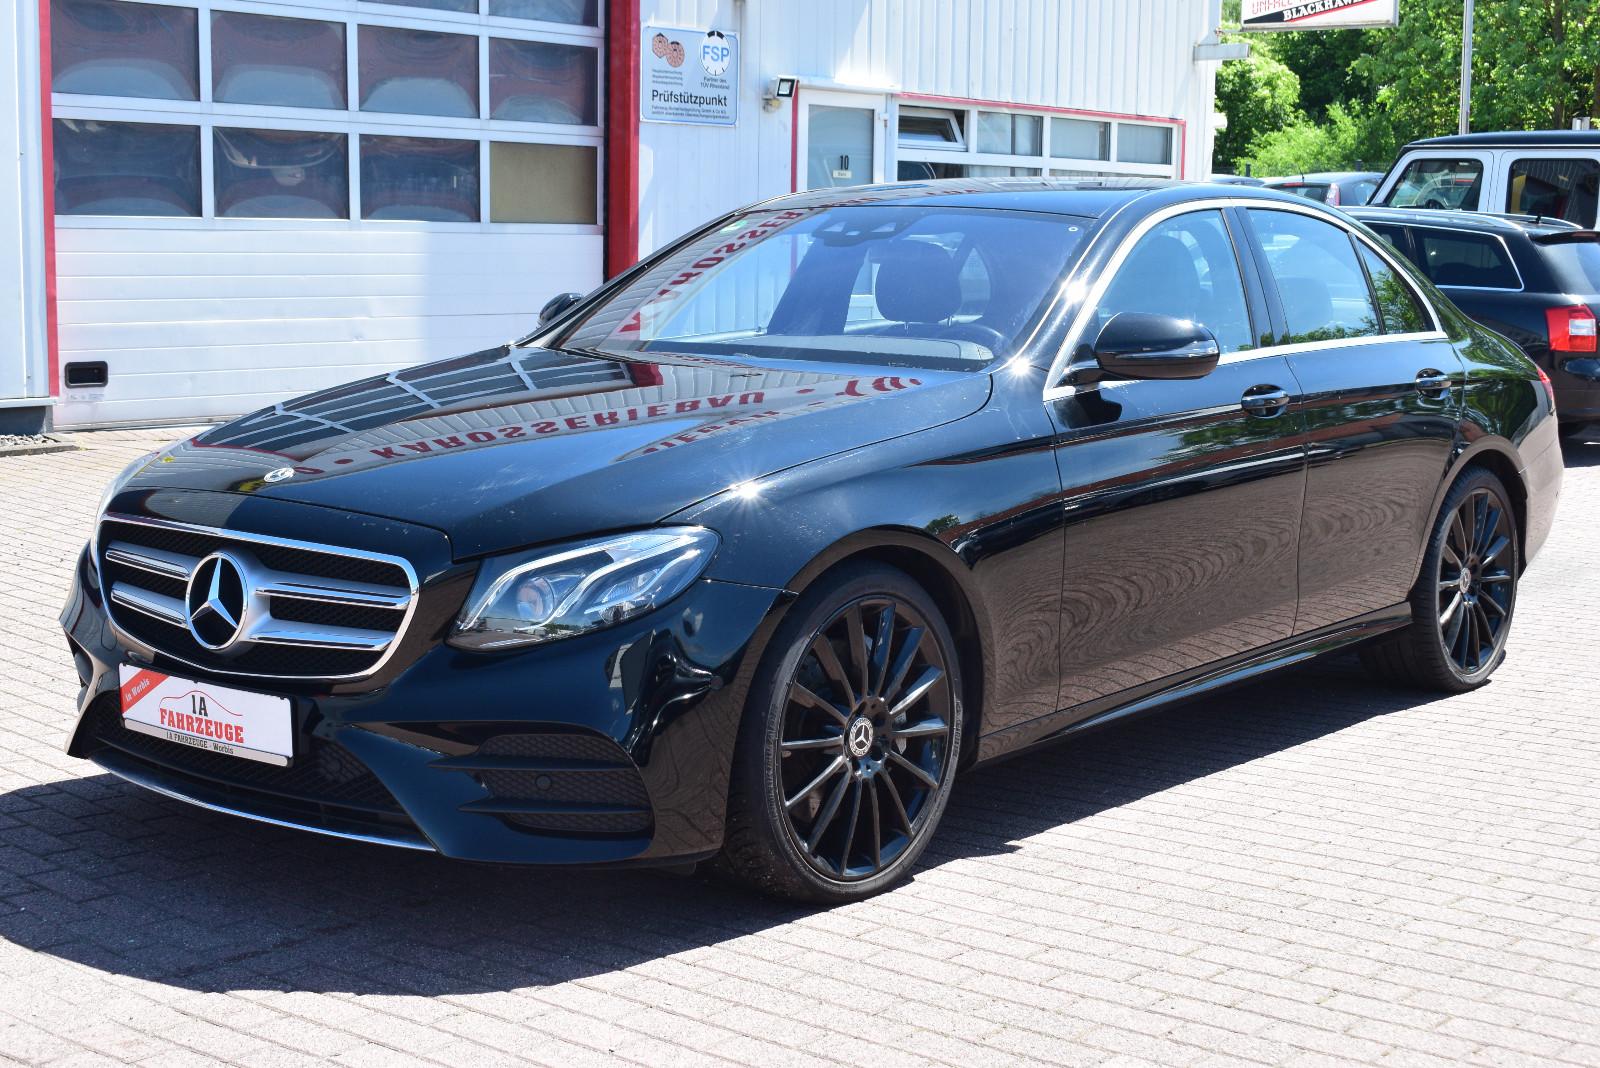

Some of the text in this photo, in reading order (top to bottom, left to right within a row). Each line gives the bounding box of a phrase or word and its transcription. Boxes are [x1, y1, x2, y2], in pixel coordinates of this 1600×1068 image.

[703, 45, 730, 62] FSP
[652, 89, 727, 107] Prüfstützpunkt
[840, 155, 849, 170] 10
[159, 708, 244, 744] FAHRZEUGE
[174, 734, 208, 749] FAHRZEUGE
